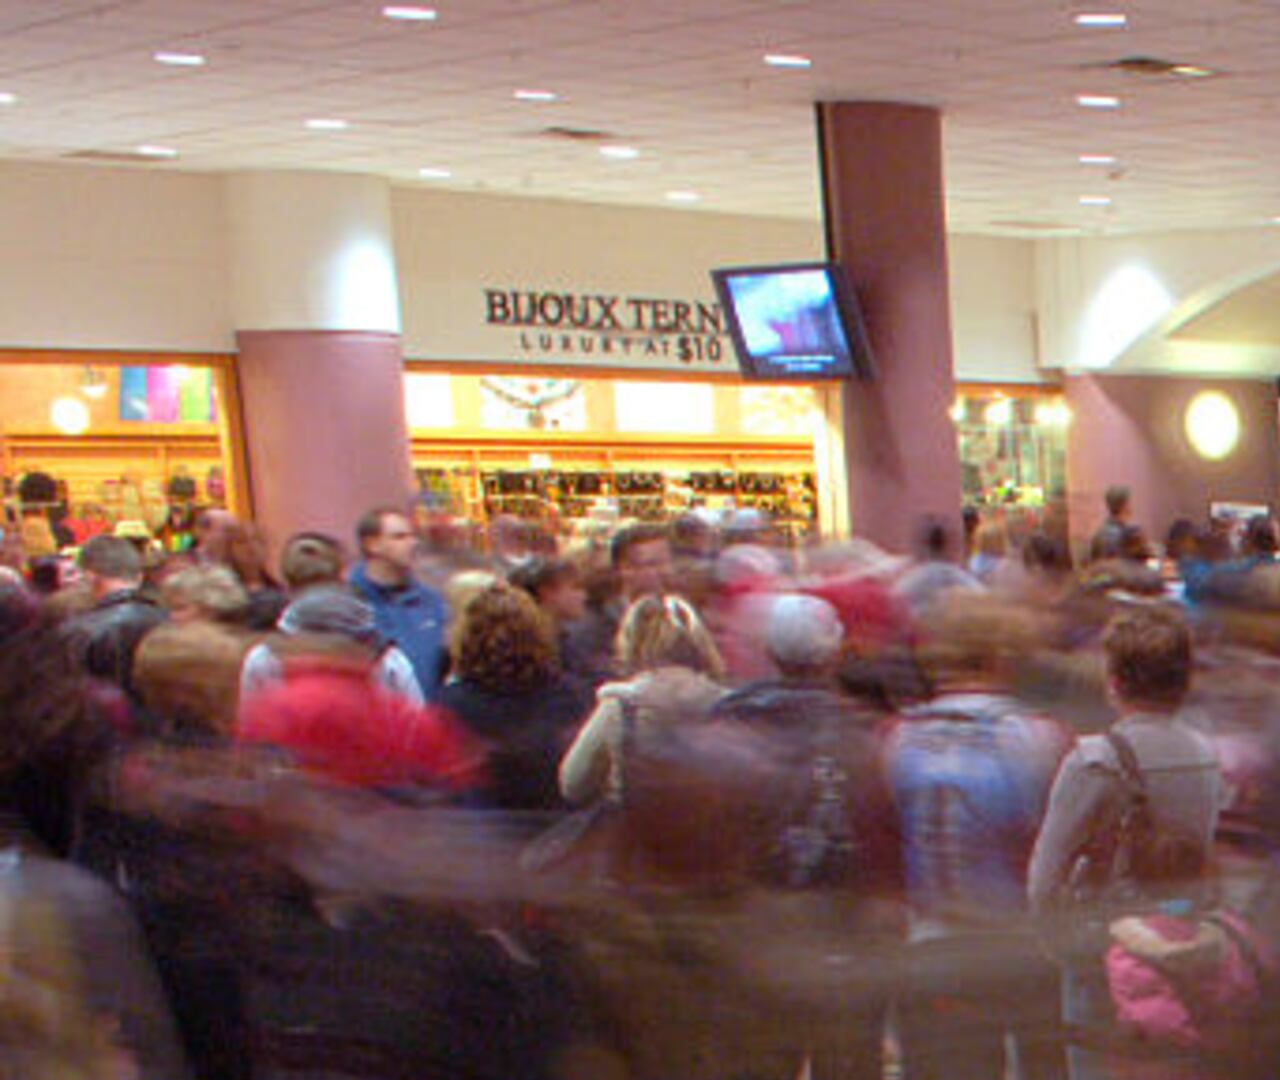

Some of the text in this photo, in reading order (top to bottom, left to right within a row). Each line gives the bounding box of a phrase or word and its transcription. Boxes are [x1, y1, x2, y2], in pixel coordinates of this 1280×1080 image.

[485, 290, 729, 334] BIJOUX TERN
[676, 334, 723, 363] $10
